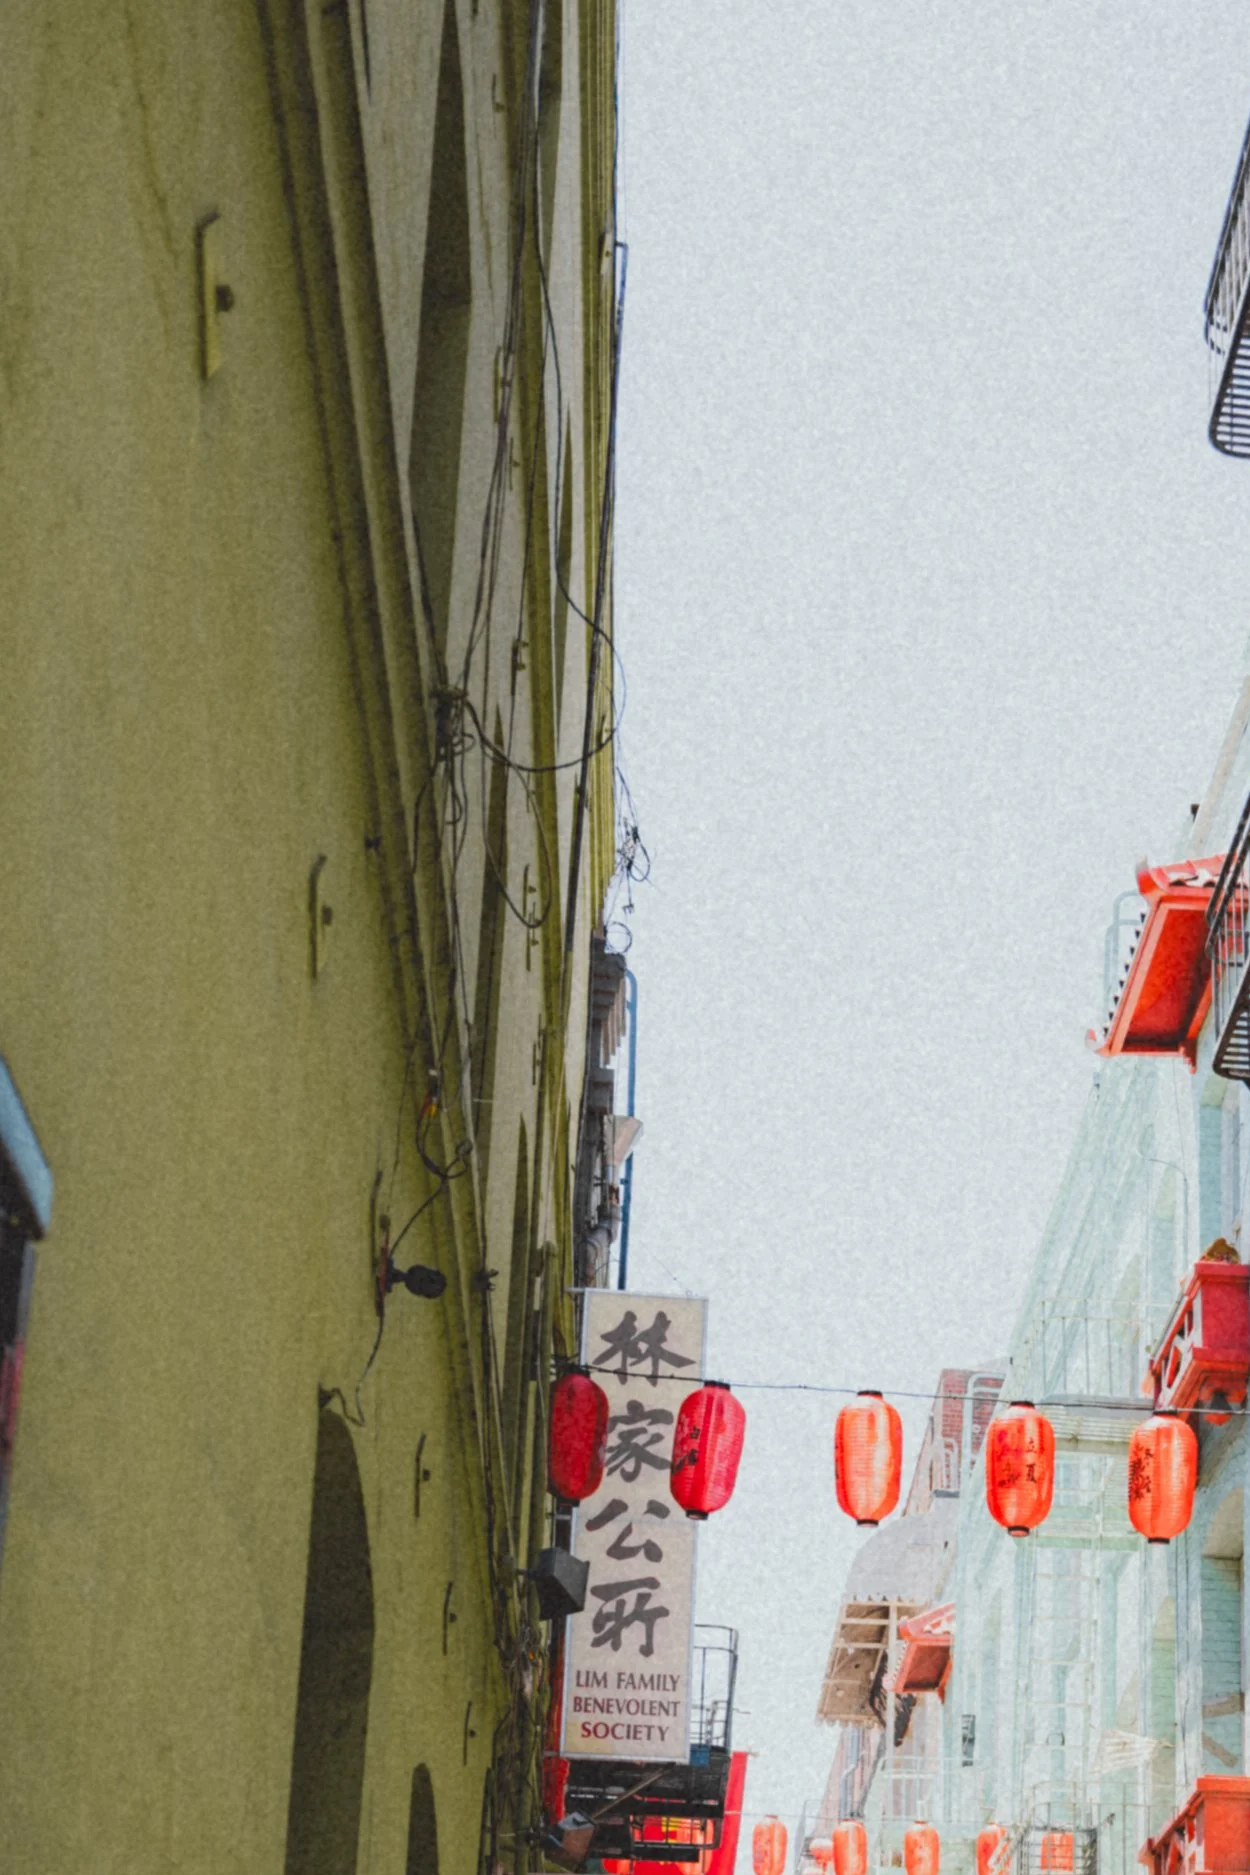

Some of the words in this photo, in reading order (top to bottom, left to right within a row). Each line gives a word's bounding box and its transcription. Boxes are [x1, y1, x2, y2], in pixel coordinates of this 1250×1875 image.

[585, 1310, 697, 1658] 林家公所
[576, 1670, 608, 1689] LIM
[616, 1671, 680, 1692] FAMILY
[573, 1696, 681, 1717] BENEVOLENT
[581, 1721, 669, 1741] SOCIETY
